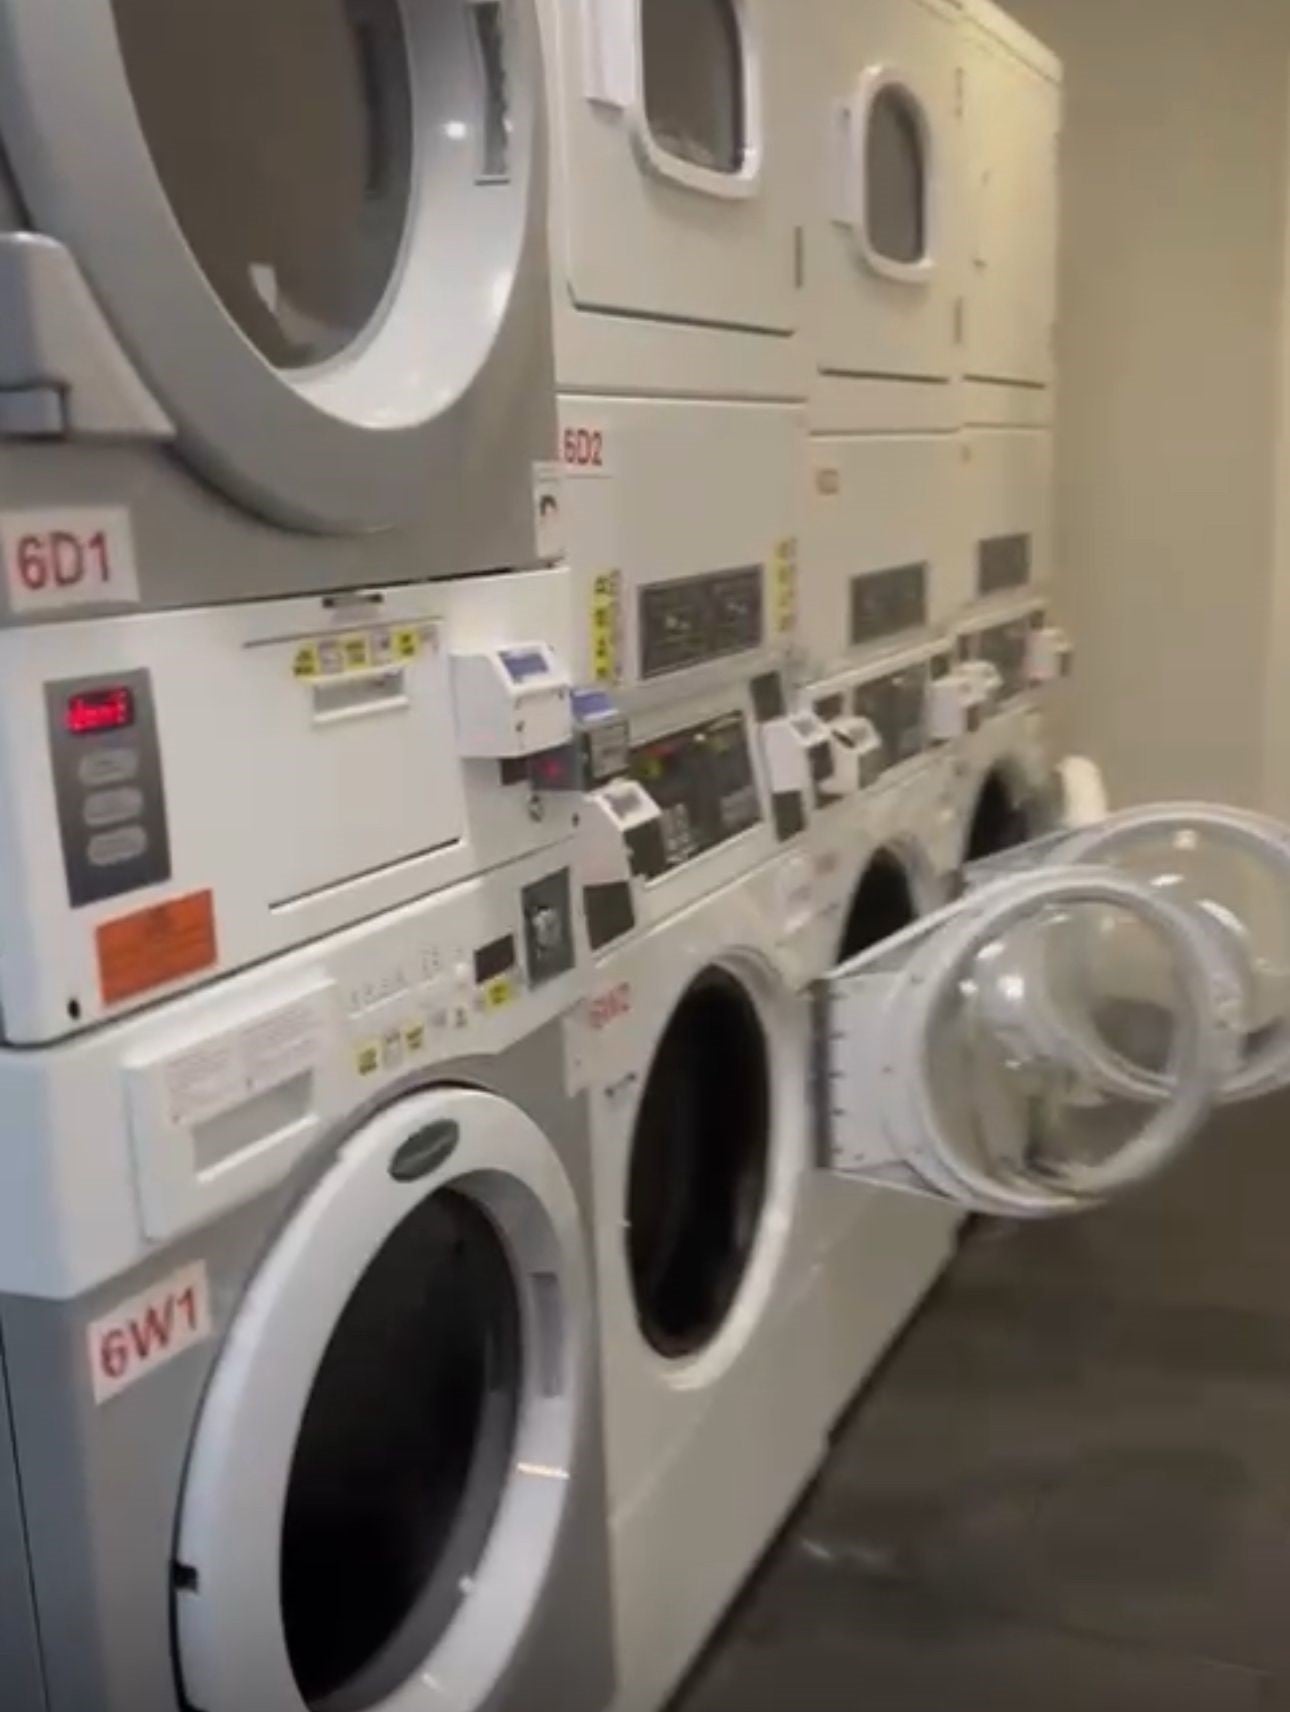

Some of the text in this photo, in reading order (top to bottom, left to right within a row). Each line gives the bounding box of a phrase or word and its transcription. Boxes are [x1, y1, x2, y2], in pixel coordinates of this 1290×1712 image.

[564, 428, 603, 467] 6D2
[17, 529, 109, 591] 6D1
[101, 1286, 197, 1379] 6W1
